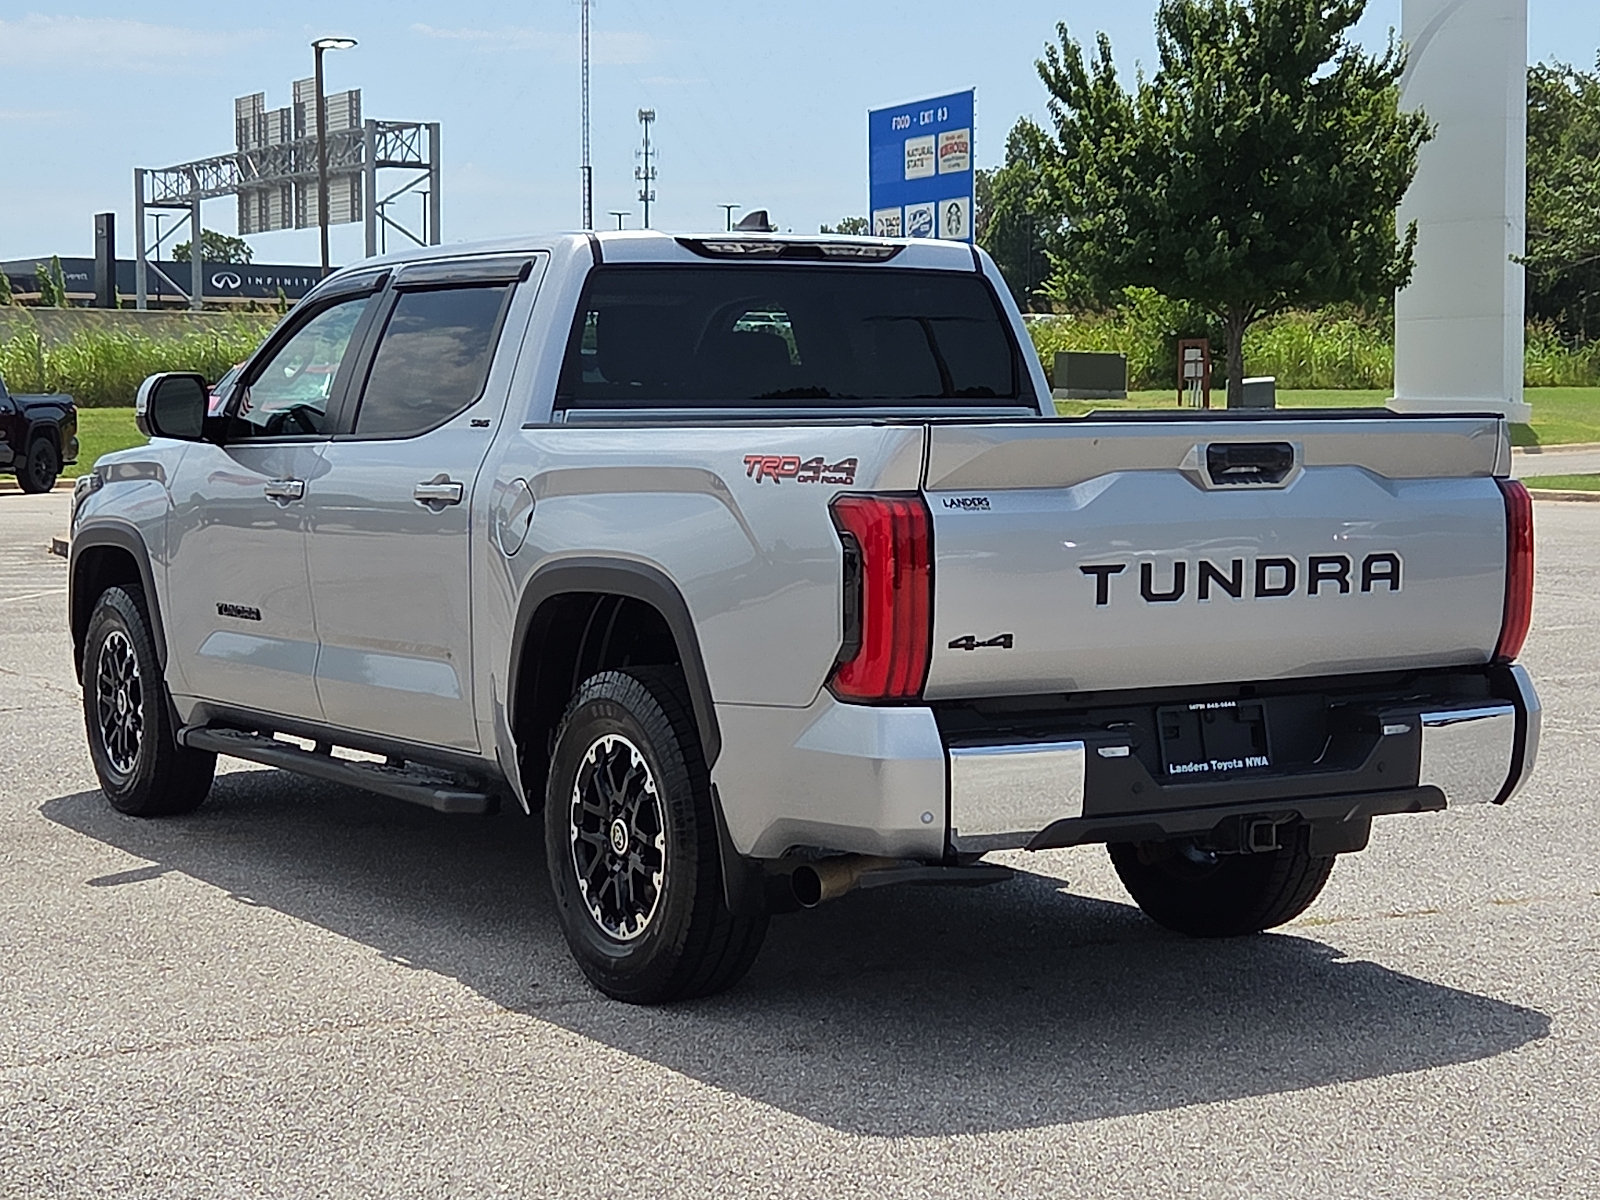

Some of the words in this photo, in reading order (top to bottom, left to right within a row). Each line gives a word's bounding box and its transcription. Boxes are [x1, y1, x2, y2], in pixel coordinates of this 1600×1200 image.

[892, 115, 910, 130] FOOD
[920, 110, 934, 125] EXIT
[907, 146, 933, 157] NATURAL
[907, 158, 924, 169] STATE
[885, 216, 900, 228] TACO
[247, 276, 316, 286] INFINITI
[743, 454, 801, 485] TRD
[797, 475, 820, 484] OFF
[820, 476, 855, 486] ROAD
[942, 497, 990, 509] LANDERS
[1079, 552, 1400, 605] TUNDRA
[216, 602, 262, 621] TUNDRA
[1169, 762, 1209, 775] Landers
[1210, 759, 1243, 772] Toyota
[1245, 755, 1270, 768] NWA
